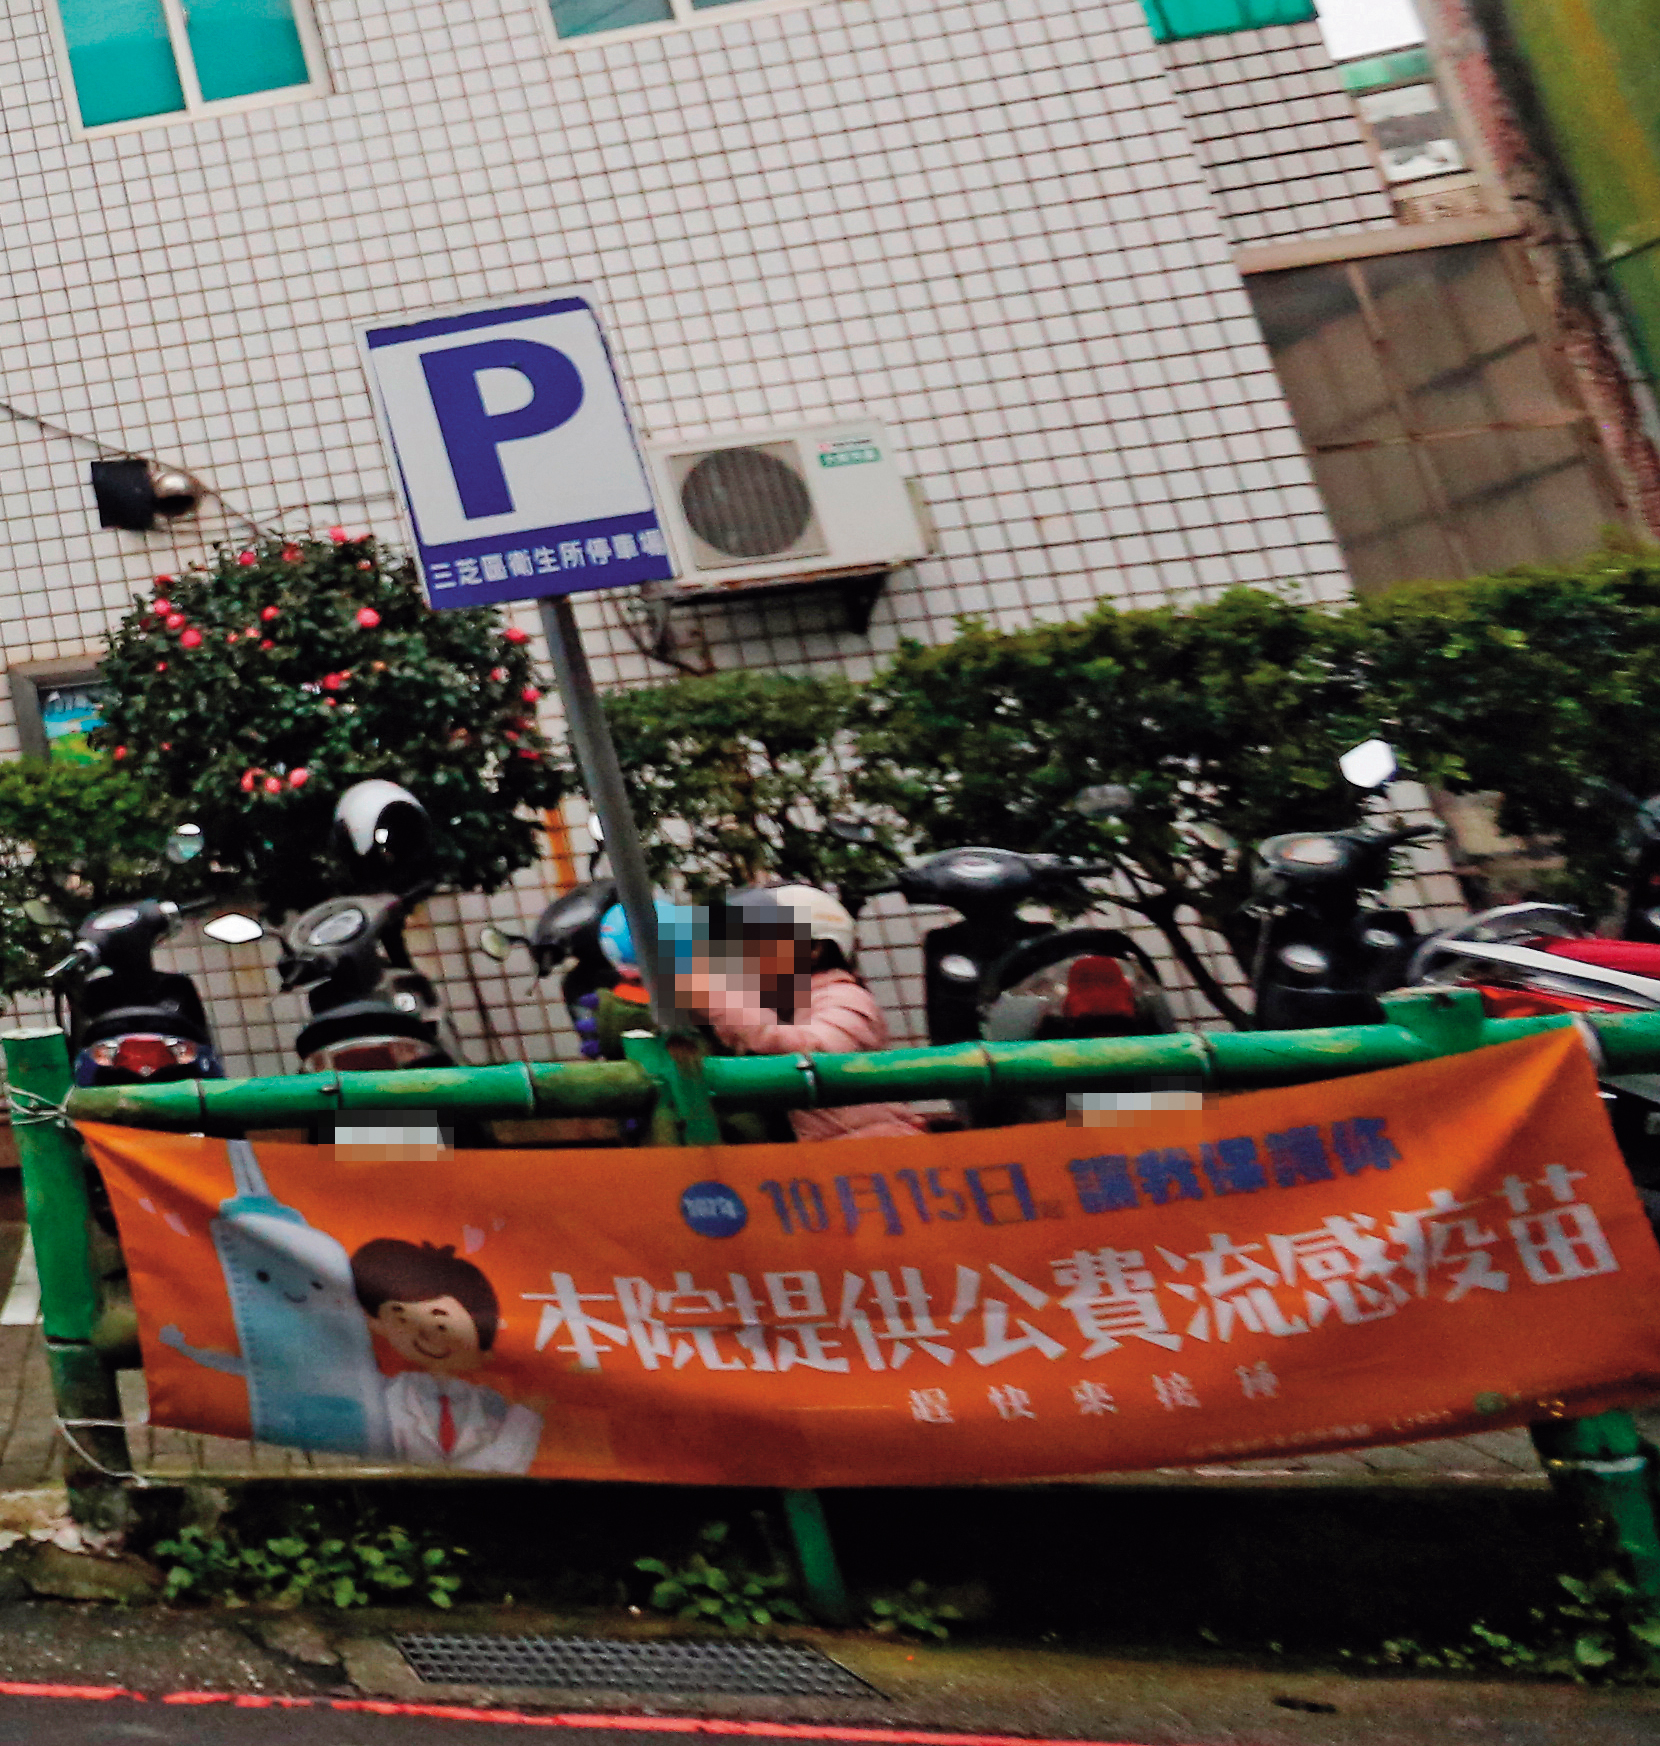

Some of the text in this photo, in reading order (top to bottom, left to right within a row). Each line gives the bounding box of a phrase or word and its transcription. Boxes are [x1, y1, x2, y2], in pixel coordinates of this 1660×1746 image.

[420, 339, 584, 521] P
[428, 527, 668, 590] 三芝區衛生所停車場
[517, 1165, 1623, 1377] 本院提供公費流感疫苗
